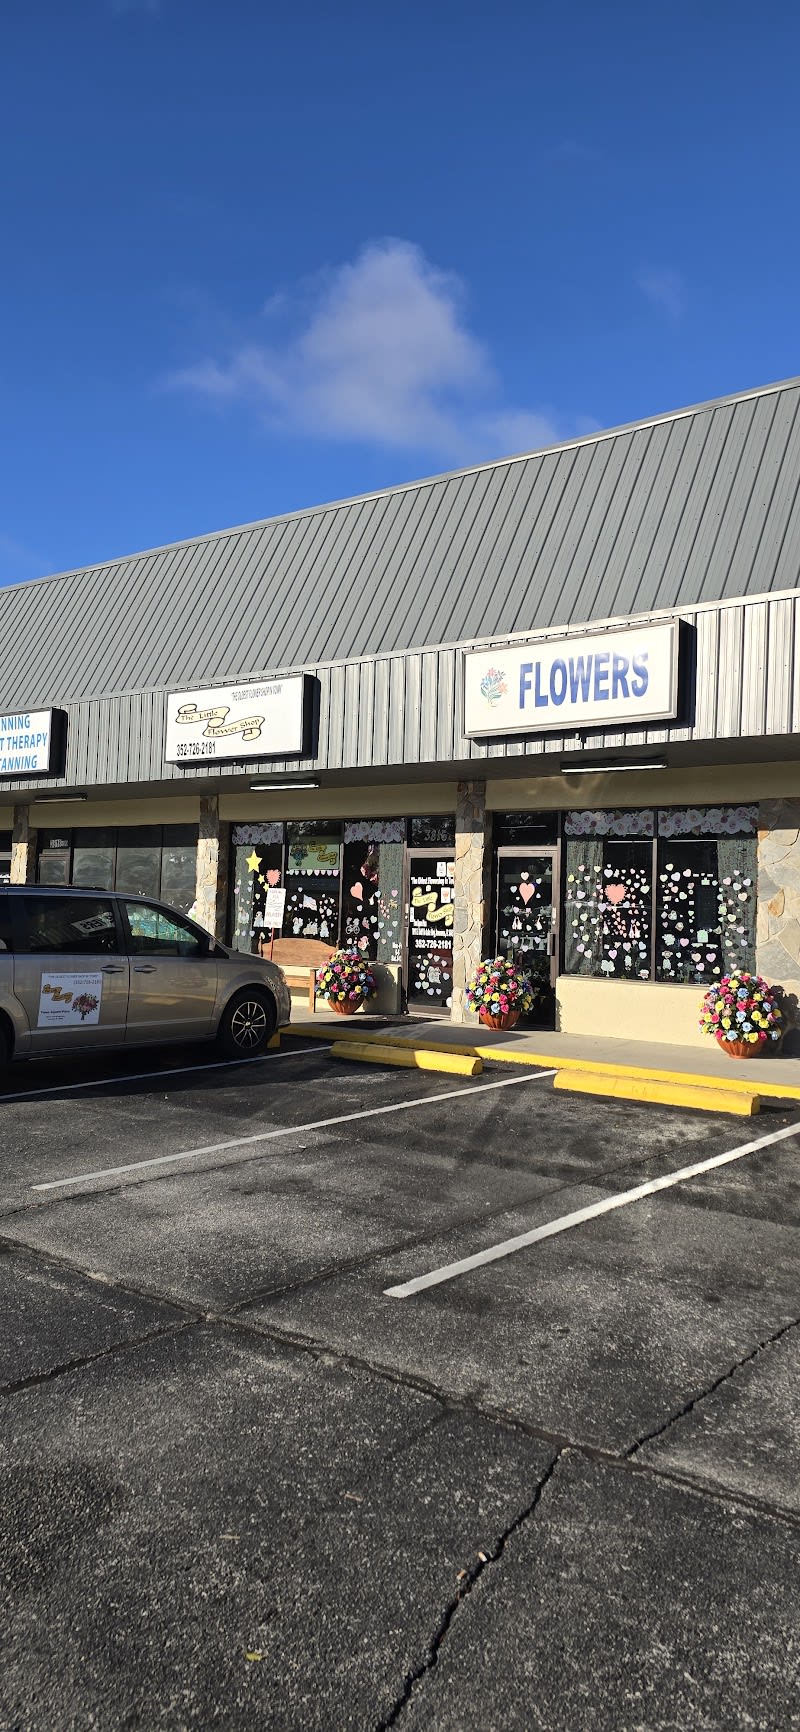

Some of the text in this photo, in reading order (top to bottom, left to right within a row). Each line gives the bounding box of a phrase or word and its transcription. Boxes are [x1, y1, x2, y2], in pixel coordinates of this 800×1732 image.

[519, 651, 649, 709] FLOWERS
[1, 714, 31, 731] NNING
[181, 710, 218, 722] The Little
[208, 718, 260, 736] Flower Shop
[6, 732, 48, 751] THERAPY
[176, 741, 216, 757] 352-726-2181
